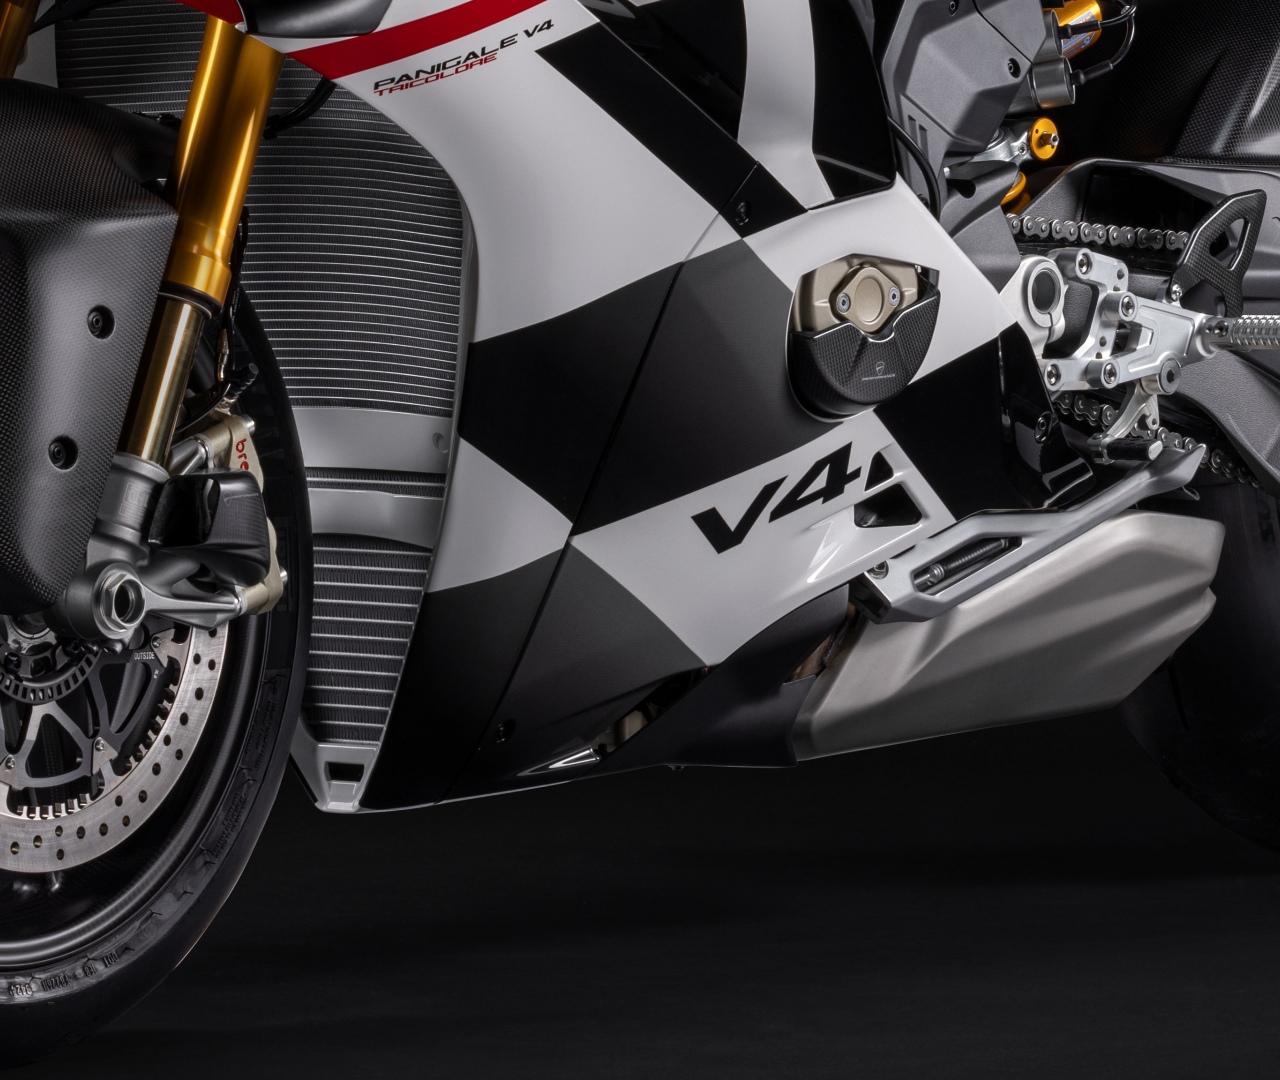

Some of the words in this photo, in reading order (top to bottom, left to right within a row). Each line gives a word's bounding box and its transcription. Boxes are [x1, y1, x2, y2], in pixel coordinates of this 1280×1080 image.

[373, 33, 518, 90] PANIGALE
[523, 19, 555, 38] V4
[373, 52, 497, 96] TRICOLORE
[236, 438, 249, 470] bre
[690, 441, 862, 554] V4
[133, 651, 155, 660] OUTSIDE
